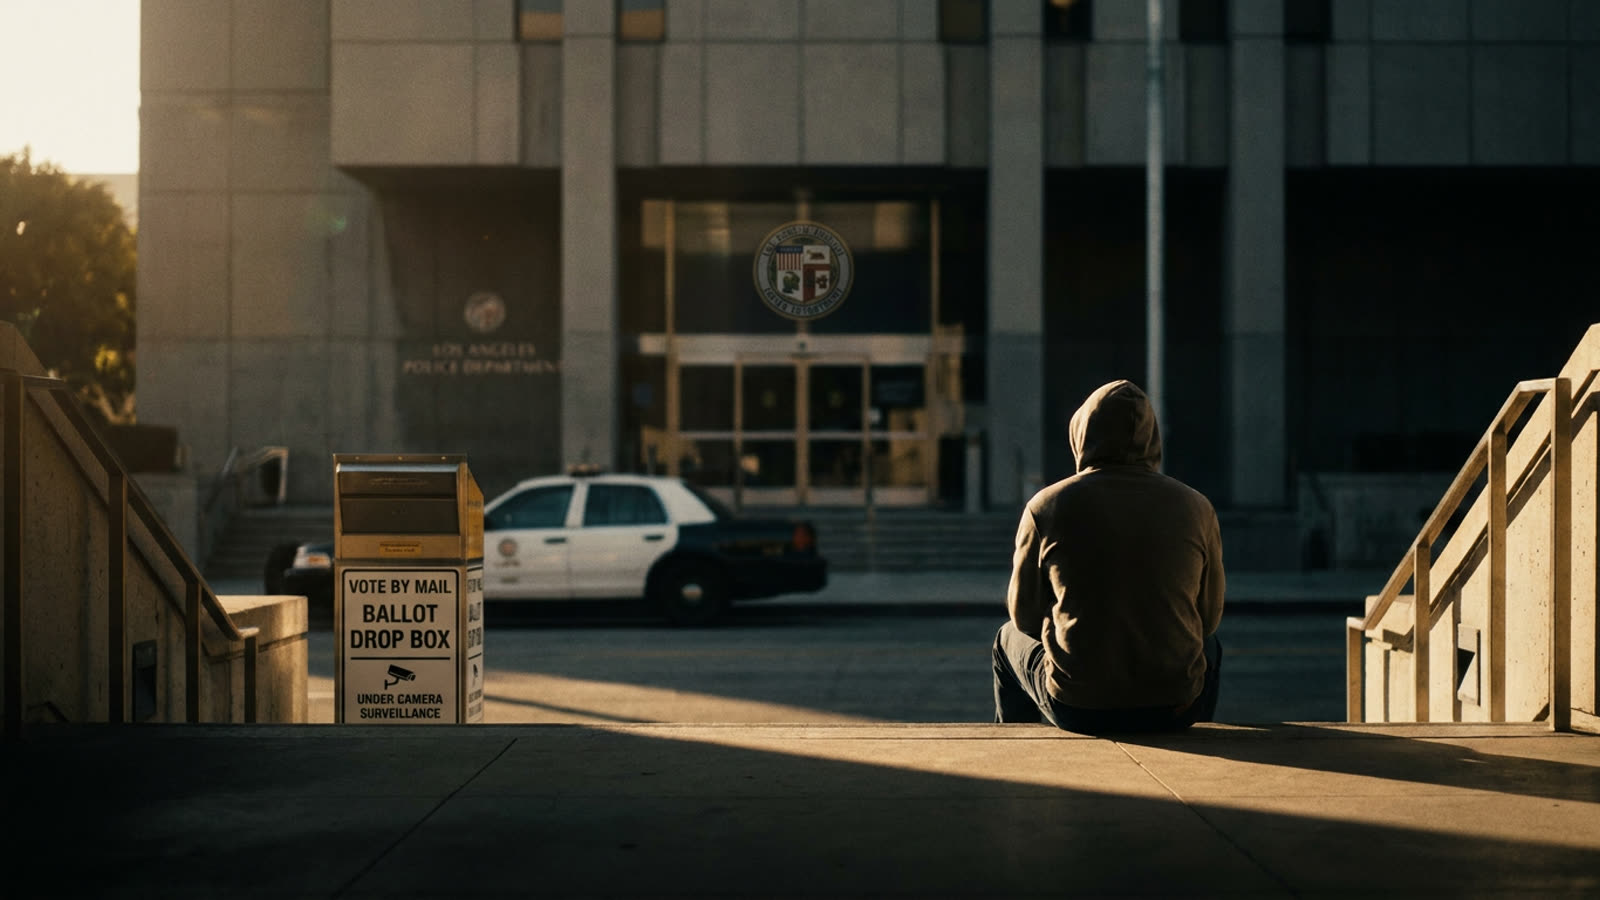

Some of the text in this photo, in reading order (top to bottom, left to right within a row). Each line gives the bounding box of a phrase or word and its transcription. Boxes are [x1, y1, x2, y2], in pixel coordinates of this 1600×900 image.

[432, 343, 536, 357] LOS ANGELES
[403, 360, 458, 375] POLICE
[349, 579, 386, 594] VOTE
[391, 579, 410, 594] BY
[415, 579, 452, 594] MAIL
[363, 604, 438, 623] BALLOT
[351, 629, 404, 649] DROP
[410, 629, 451, 649] BOX
[357, 694, 443, 705] UNDER CAMERA
[360, 708, 441, 719] SURVEILLANCE
